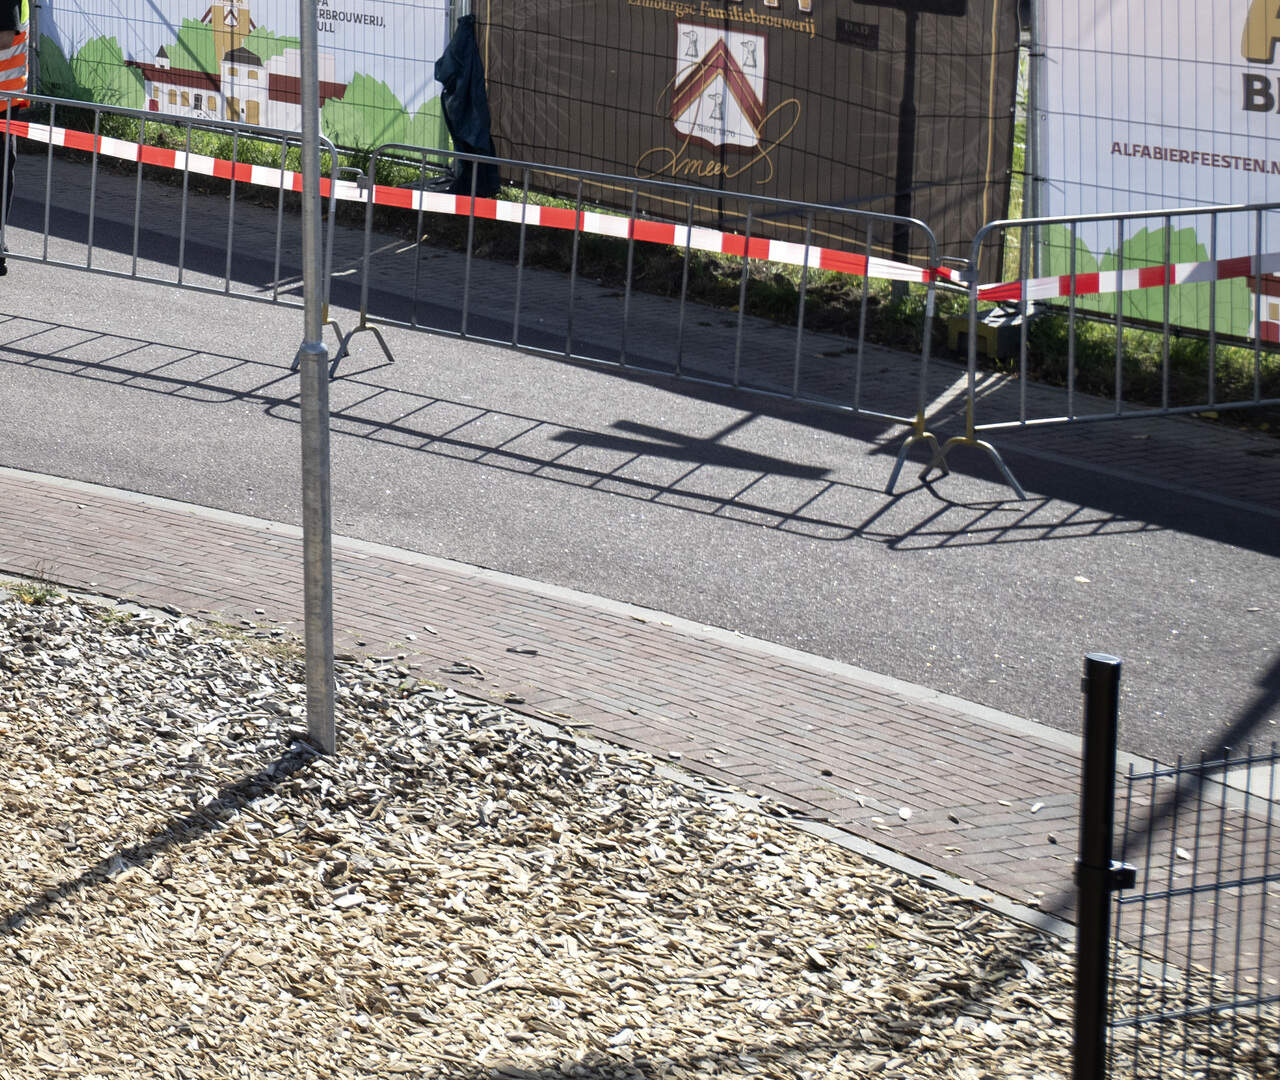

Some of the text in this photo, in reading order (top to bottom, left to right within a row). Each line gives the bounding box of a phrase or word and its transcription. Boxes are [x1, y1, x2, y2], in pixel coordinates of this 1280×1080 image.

[316, 8, 386, 29] RBROUWERIJ,
[316, 21, 335, 33] ULL
[699, 0, 816, 39] Familiebrouwerij
[1110, 140, 1280, 175] ALFABIERFEESTEN.N
